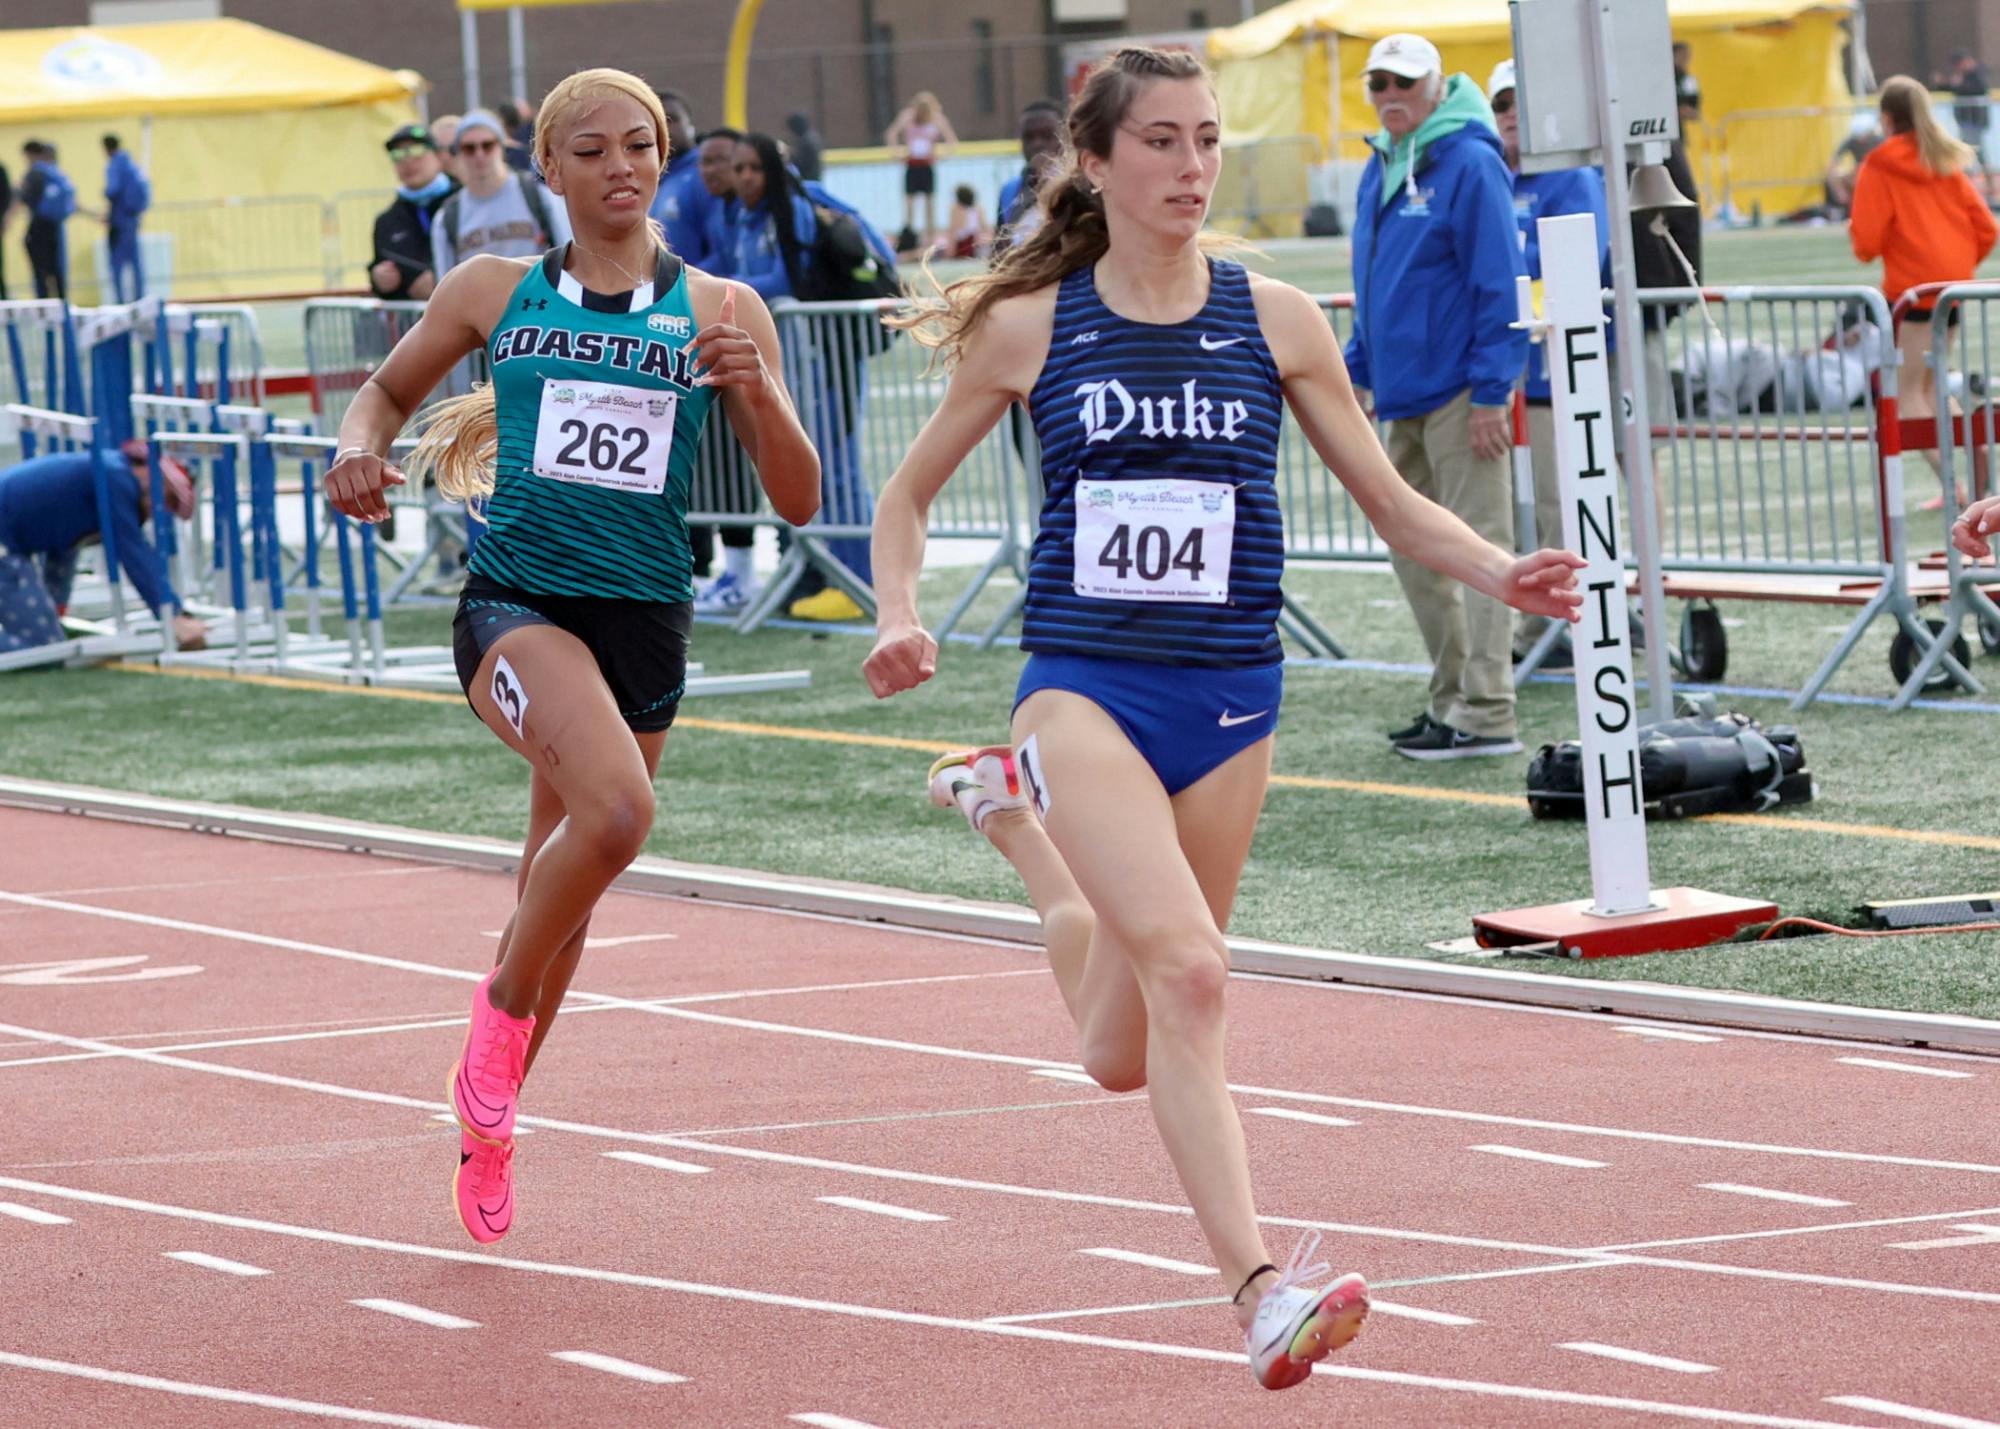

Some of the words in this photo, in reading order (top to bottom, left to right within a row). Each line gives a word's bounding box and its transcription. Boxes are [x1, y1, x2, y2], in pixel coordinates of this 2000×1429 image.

[1629, 118, 1667, 136] GILL
[648, 313, 690, 338] SBC
[1070, 330, 1100, 346] ACC
[493, 325, 694, 392] COASTAL
[1073, 378, 1249, 446] Duke
[555, 418, 650, 476] 262
[1098, 523, 1206, 581] 404
[1564, 326, 1639, 819] FINISH
[494, 670, 520, 728] 3
